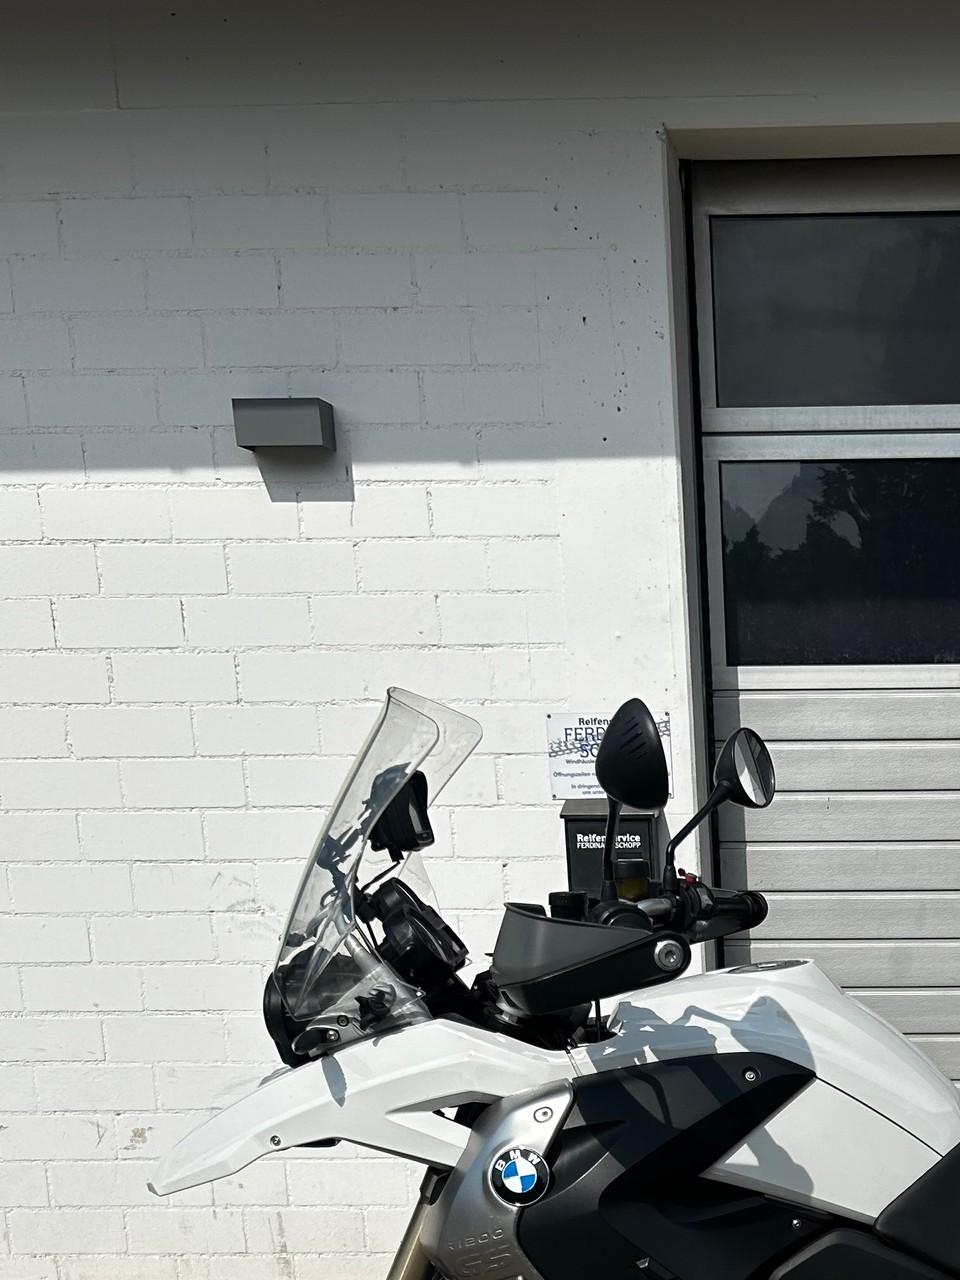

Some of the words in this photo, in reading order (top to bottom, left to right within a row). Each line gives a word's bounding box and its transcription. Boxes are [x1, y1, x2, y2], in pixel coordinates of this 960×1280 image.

[564, 726, 606, 742] FERD
[615, 841, 641, 849] SCHOPP
[495, 1149, 541, 1172] BMW
